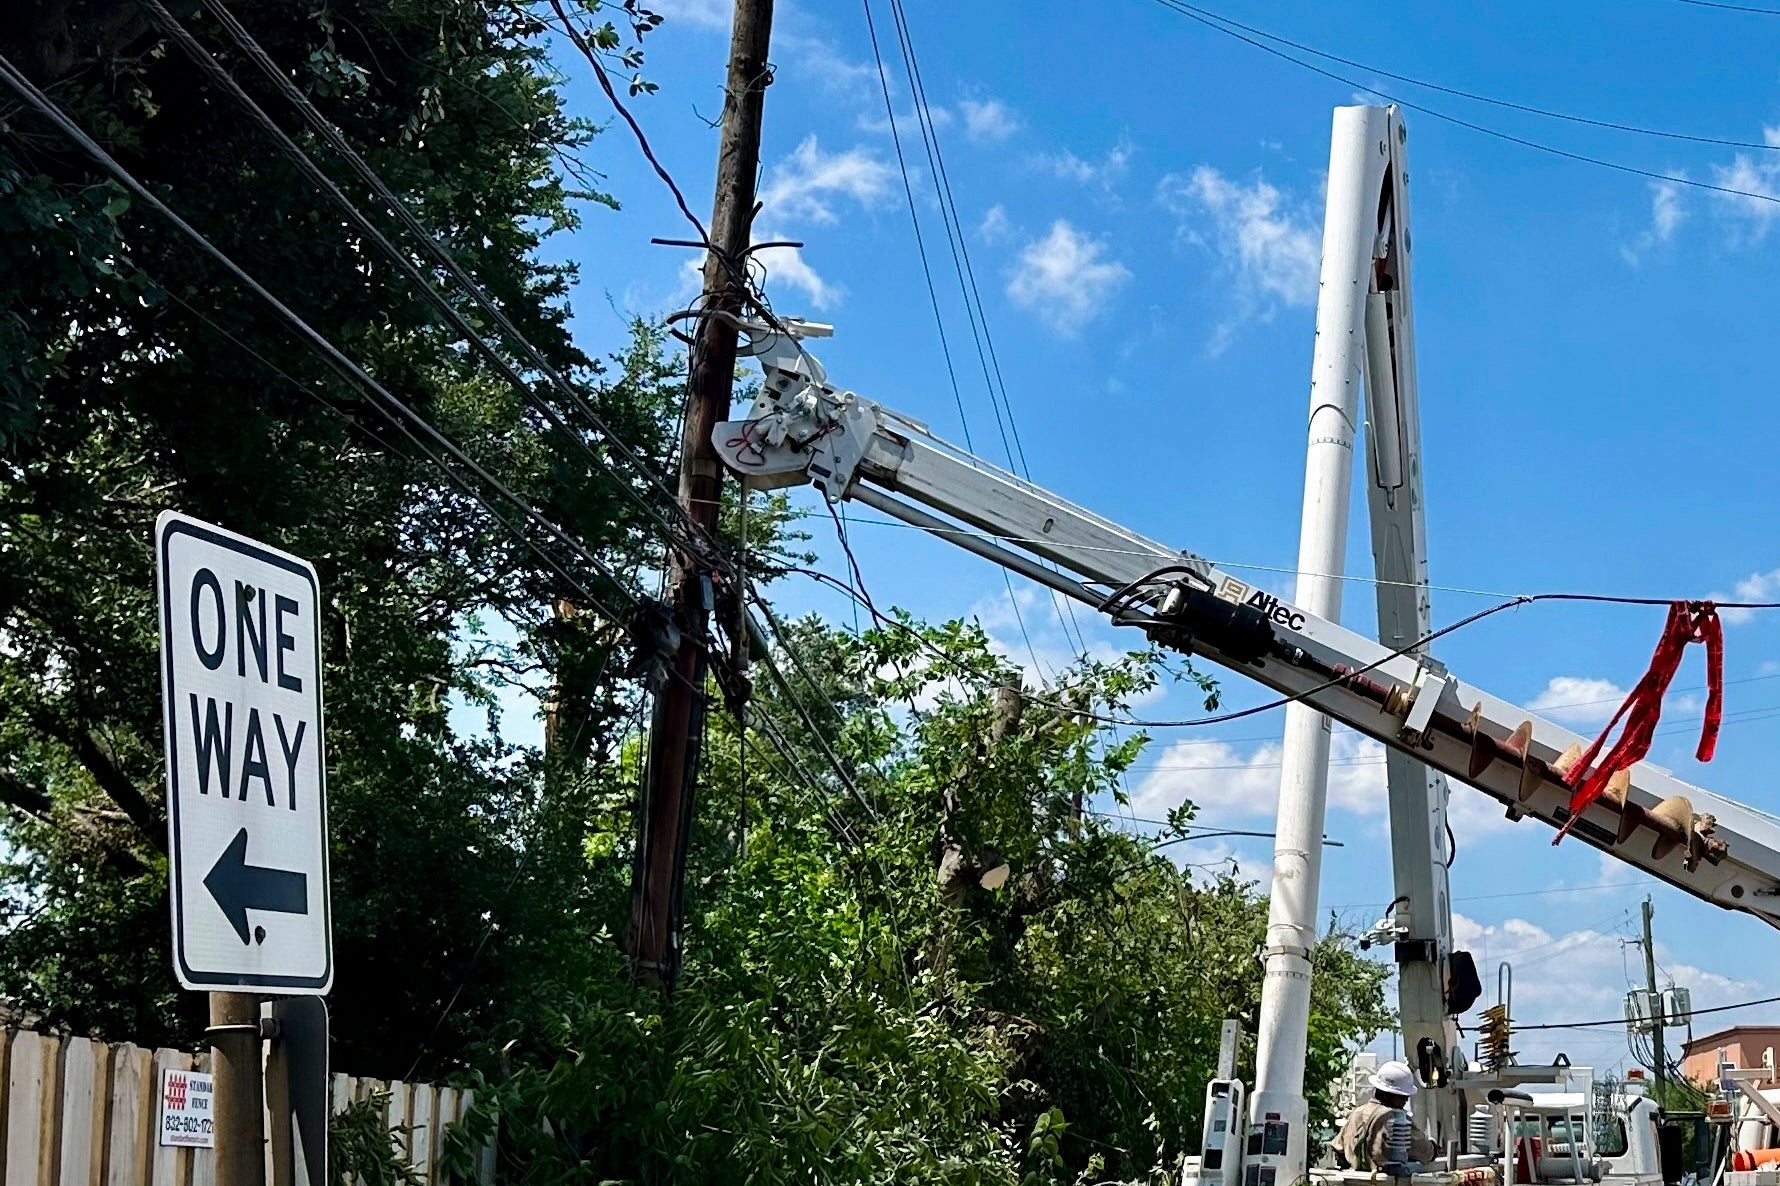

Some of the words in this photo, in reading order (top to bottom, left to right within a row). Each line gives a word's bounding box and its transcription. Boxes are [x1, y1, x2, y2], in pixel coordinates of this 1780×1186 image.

[190, 567, 303, 694] ONE
[1246, 590, 1306, 631] Altec
[189, 693, 307, 811] WAY
